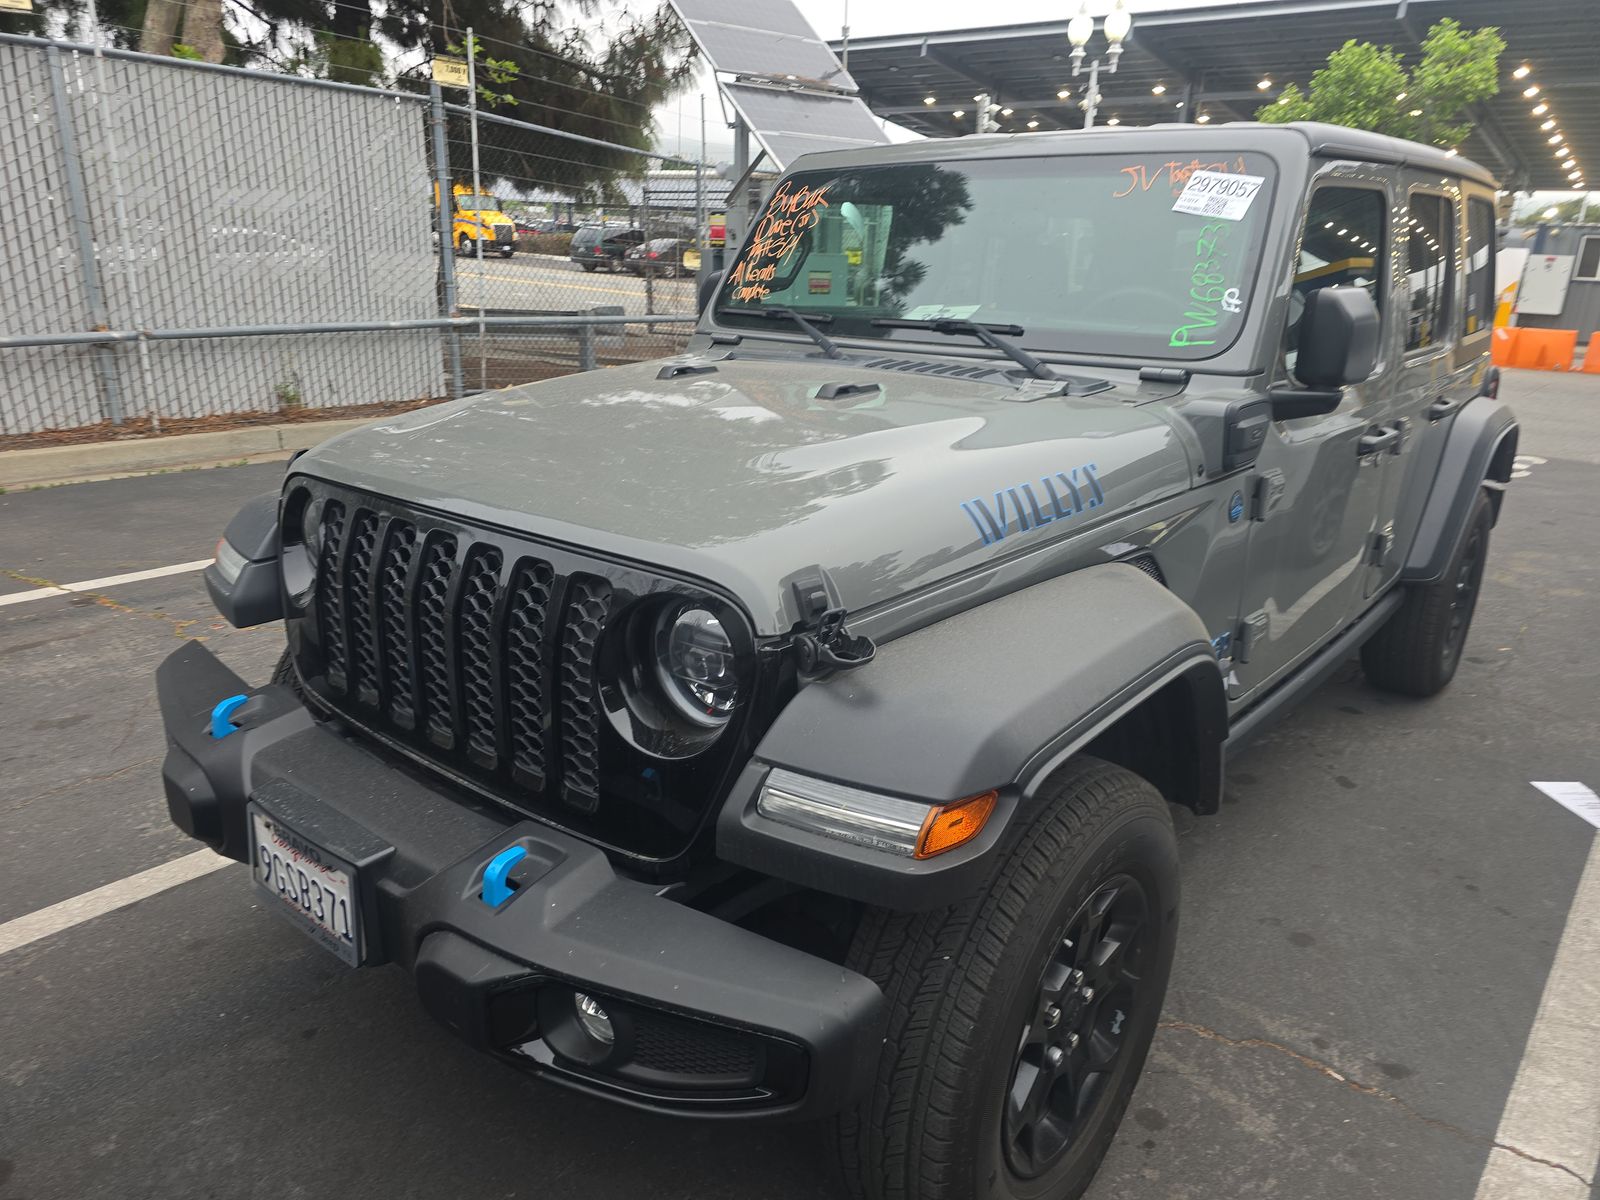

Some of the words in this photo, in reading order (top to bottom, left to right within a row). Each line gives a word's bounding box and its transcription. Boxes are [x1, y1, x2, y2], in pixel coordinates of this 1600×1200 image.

[1187, 175, 1262, 198] 2979057
[1168, 217, 1231, 346] PW68373
[959, 463, 1105, 547] WILLYS
[260, 844, 353, 943] 9GSB371
